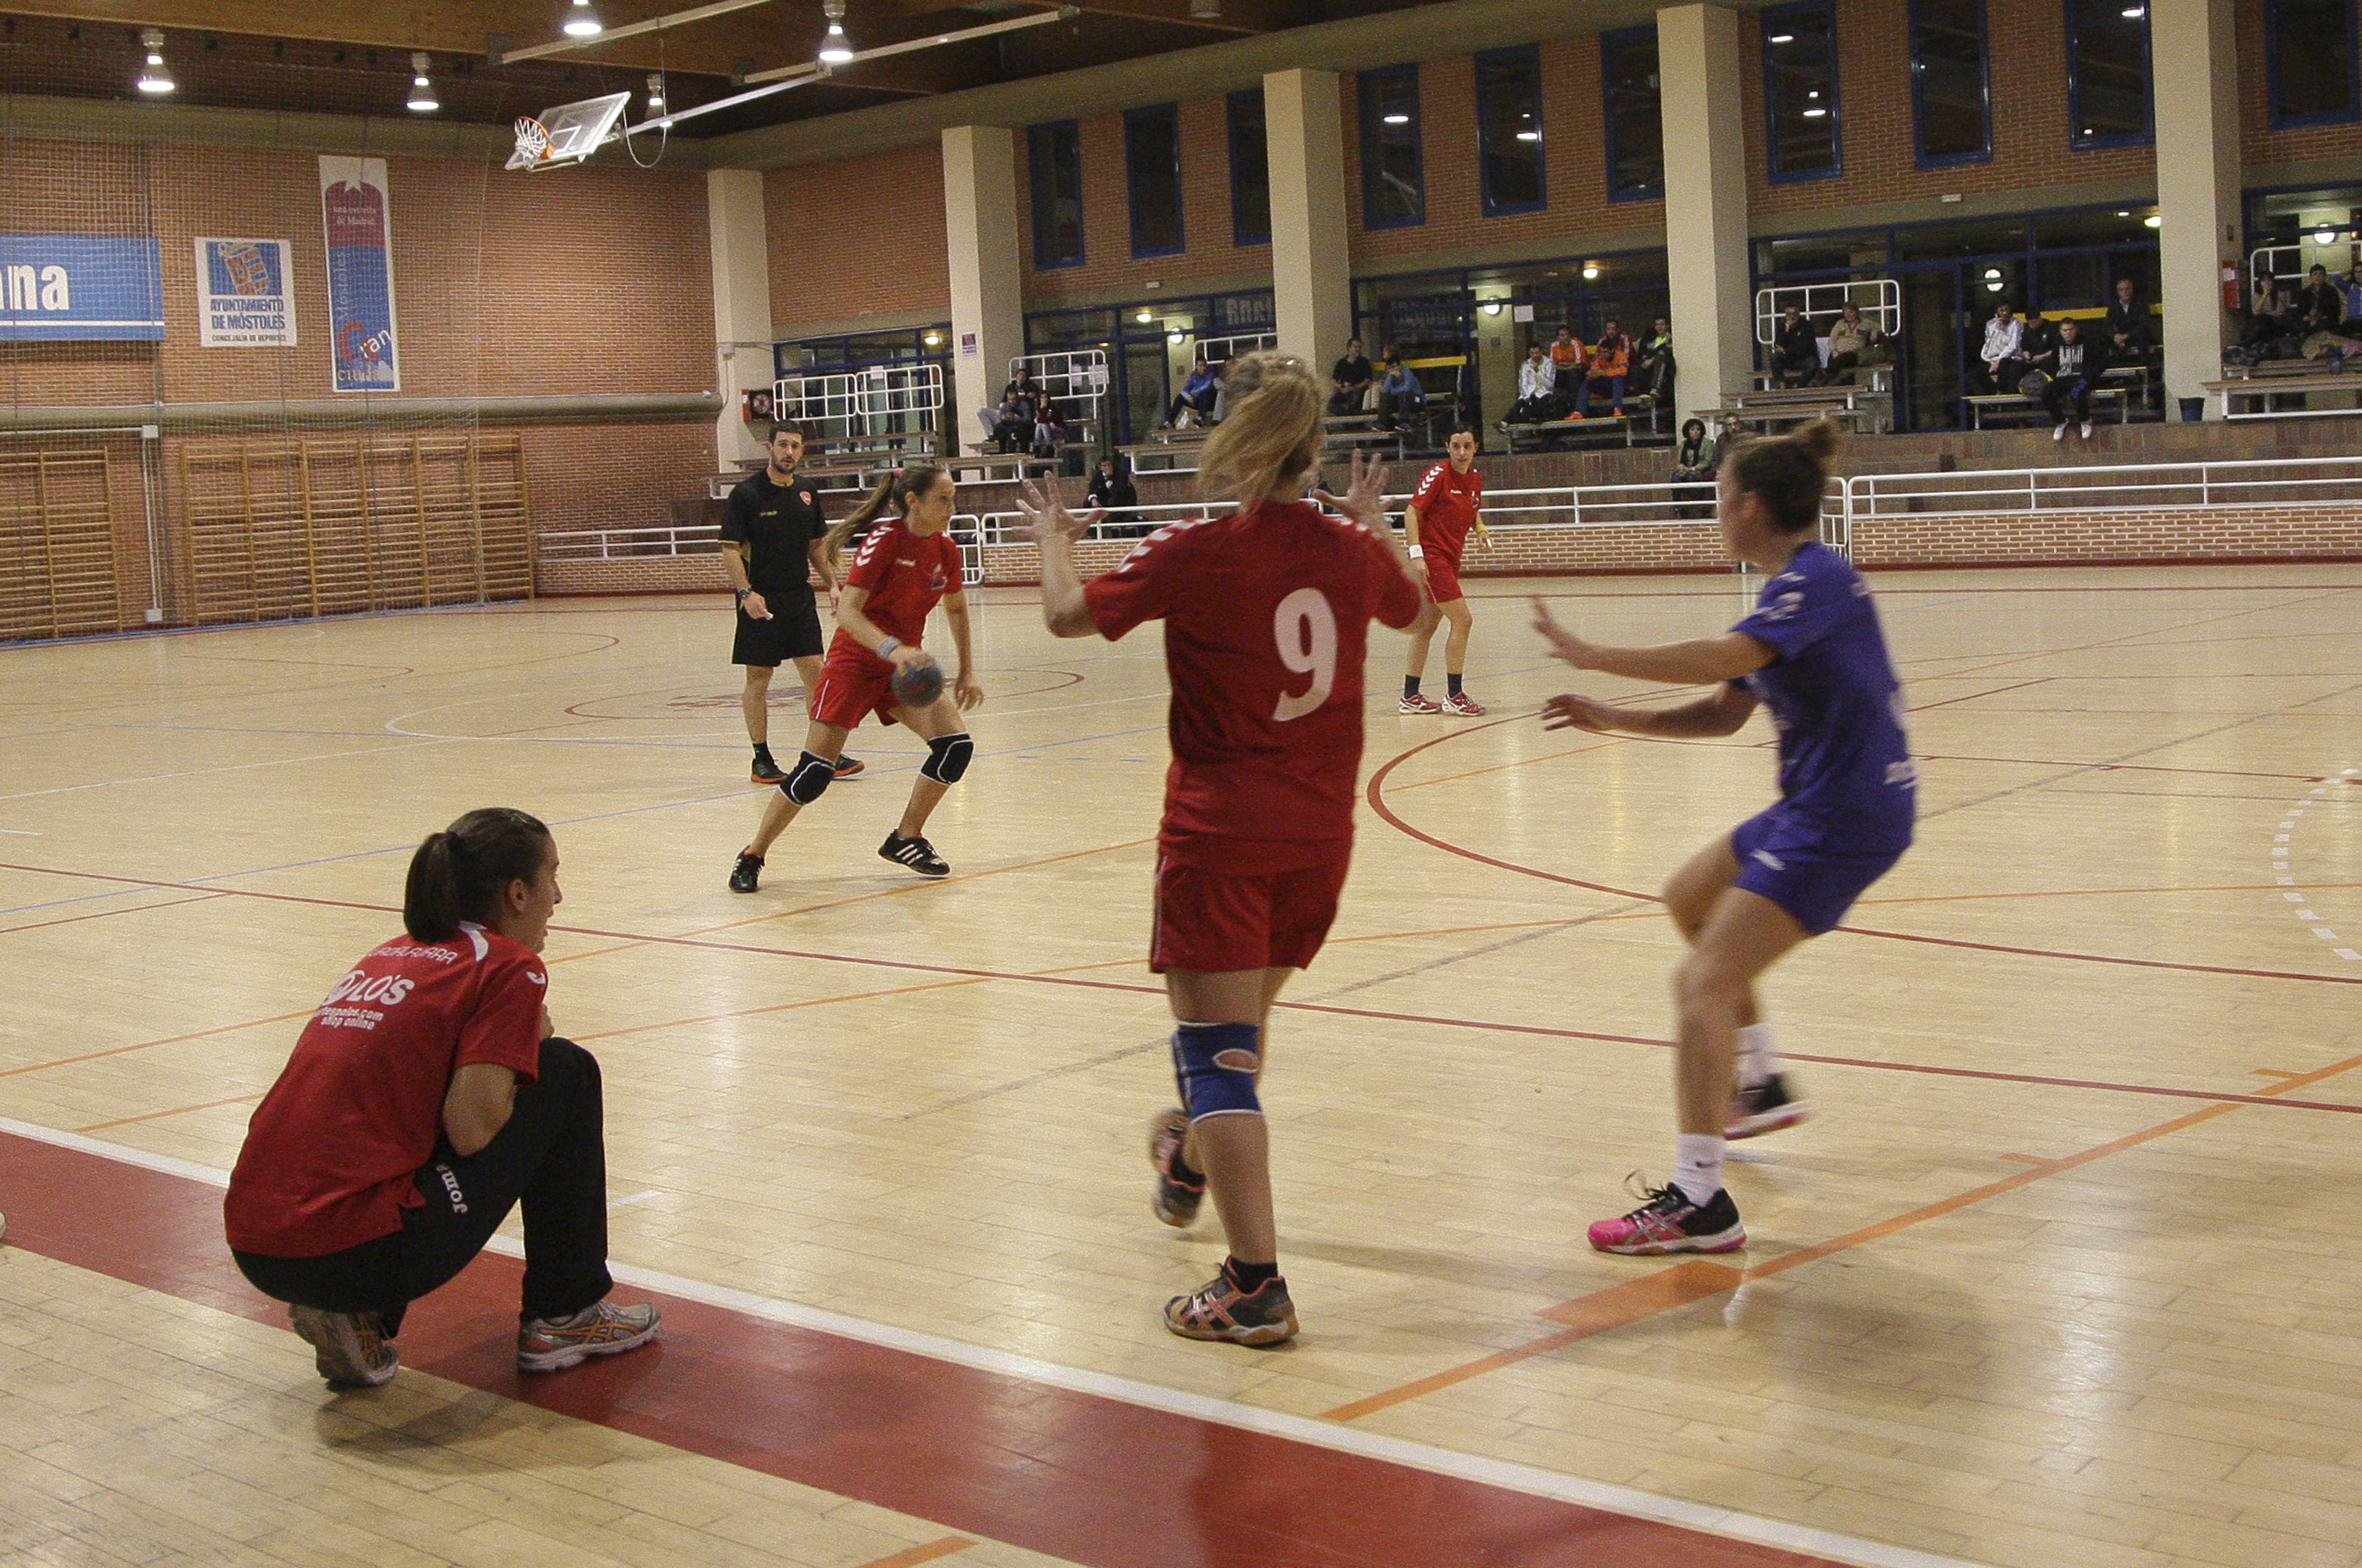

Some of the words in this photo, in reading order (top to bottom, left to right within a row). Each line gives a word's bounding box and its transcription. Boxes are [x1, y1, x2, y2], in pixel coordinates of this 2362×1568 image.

[0, 265, 70, 311] na
[210, 299, 284, 312] AYUNTAMIENTO
[212, 315, 226, 329] DE
[1274, 587, 1338, 722] 9
